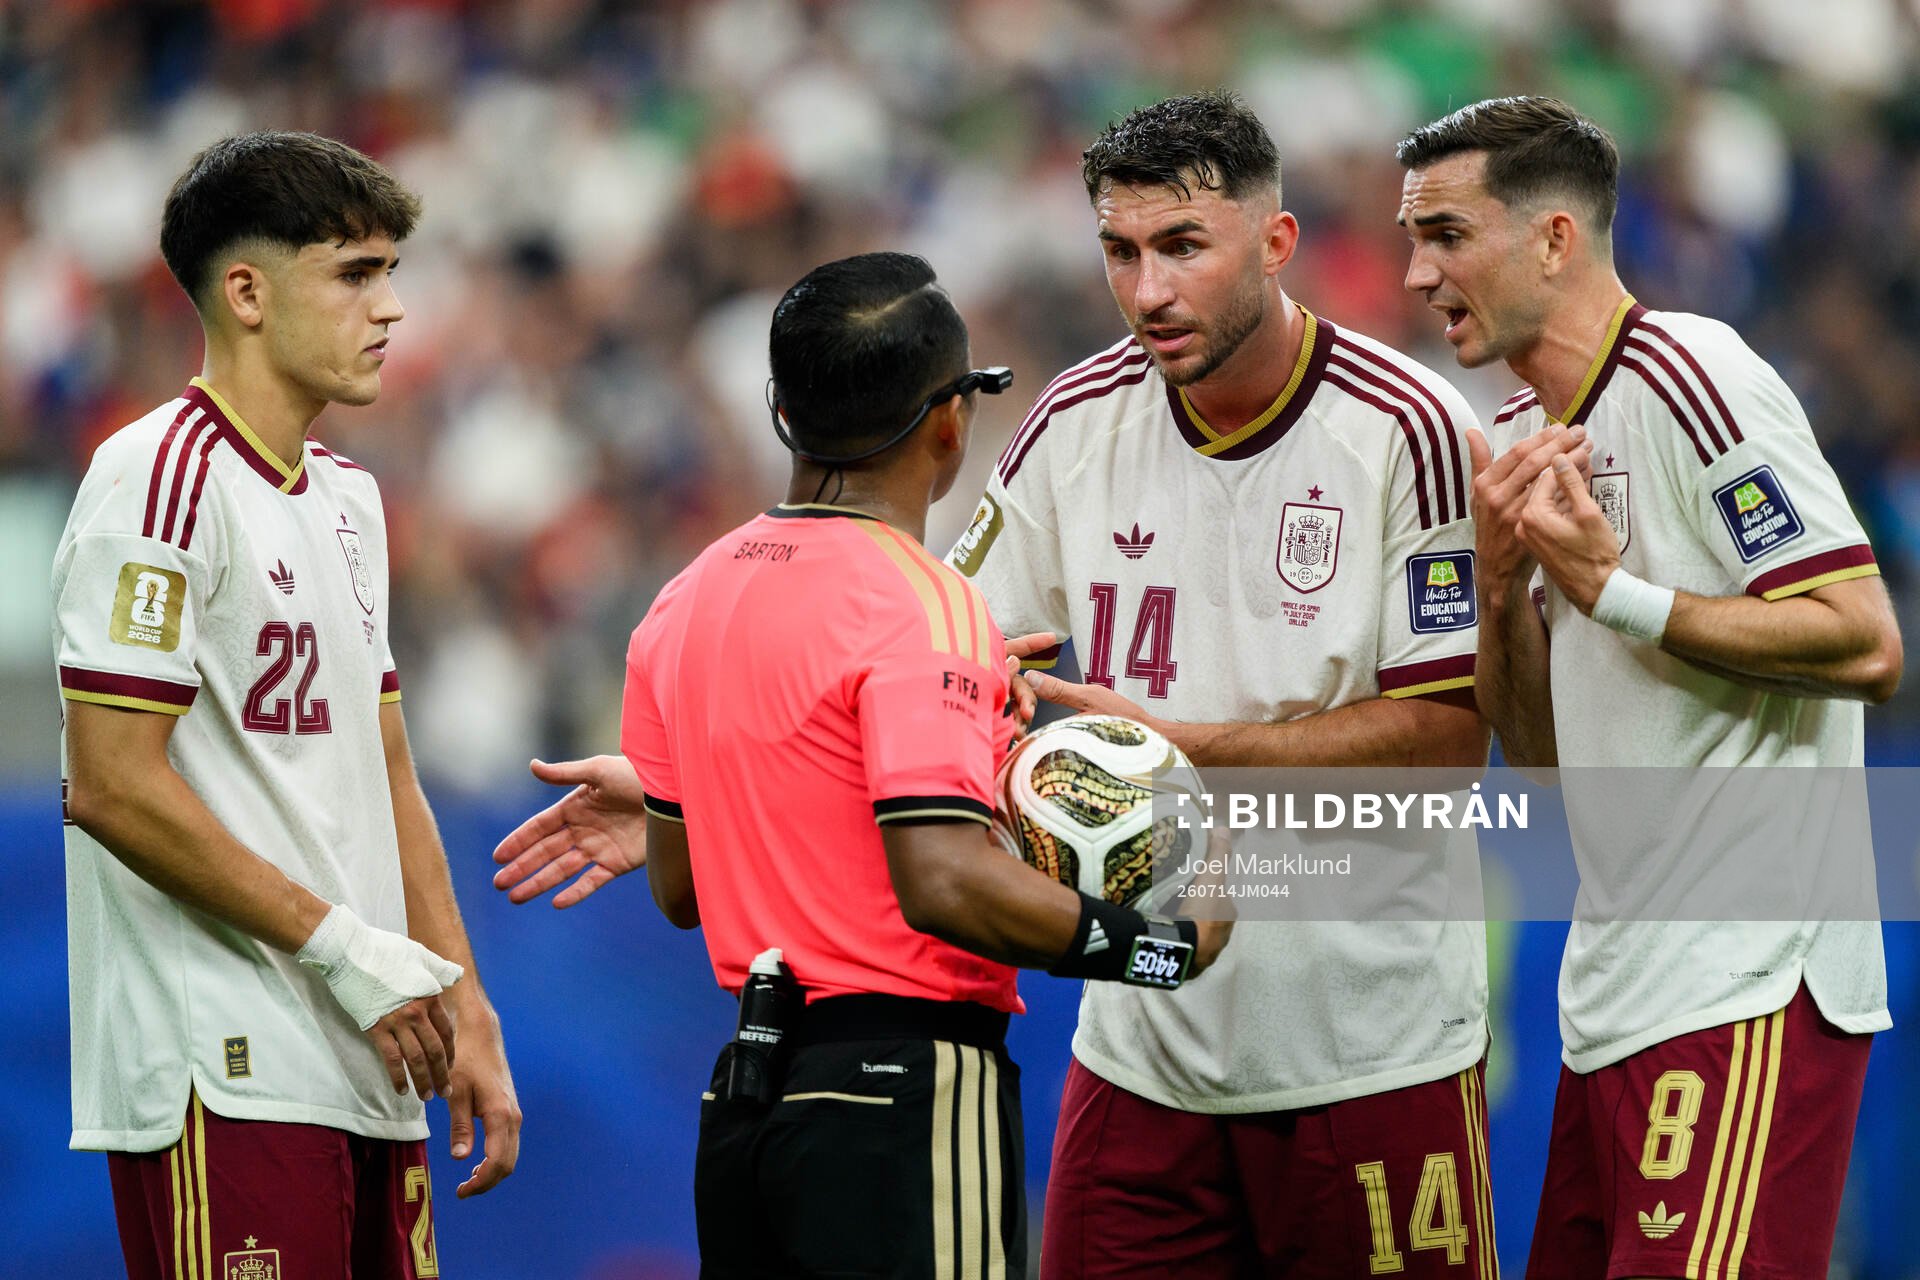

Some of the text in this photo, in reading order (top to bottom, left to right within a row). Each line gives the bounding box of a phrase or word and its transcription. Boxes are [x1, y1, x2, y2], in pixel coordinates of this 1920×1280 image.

[1741, 502, 1775, 529] Unite For
[1742, 512, 1789, 545] EDUCATION
[1761, 532, 1779, 546] FIFA
[734, 542, 799, 562] BARTON
[1426, 586, 1463, 603] Unite For
[141, 613, 156, 622] FIFA
[1302, 612, 1316, 621] 2026
[1421, 600, 1470, 617] EDUCATION
[1436, 615, 1456, 624] FIFA
[129, 624, 150, 634] WORLD
[1288, 618, 1308, 627] DALLAS
[127, 630, 161, 644] 2026
[1085, 582, 1177, 699] 14
[241, 621, 332, 735] 22
[943, 671, 979, 704] FIFA
[1040, 782, 1132, 815] ATLANTA
[1132, 951, 1180, 977] 4405
[1639, 1070, 1706, 1181] 8
[404, 1165, 439, 1279] 2
[1355, 1152, 1470, 1275] 14
